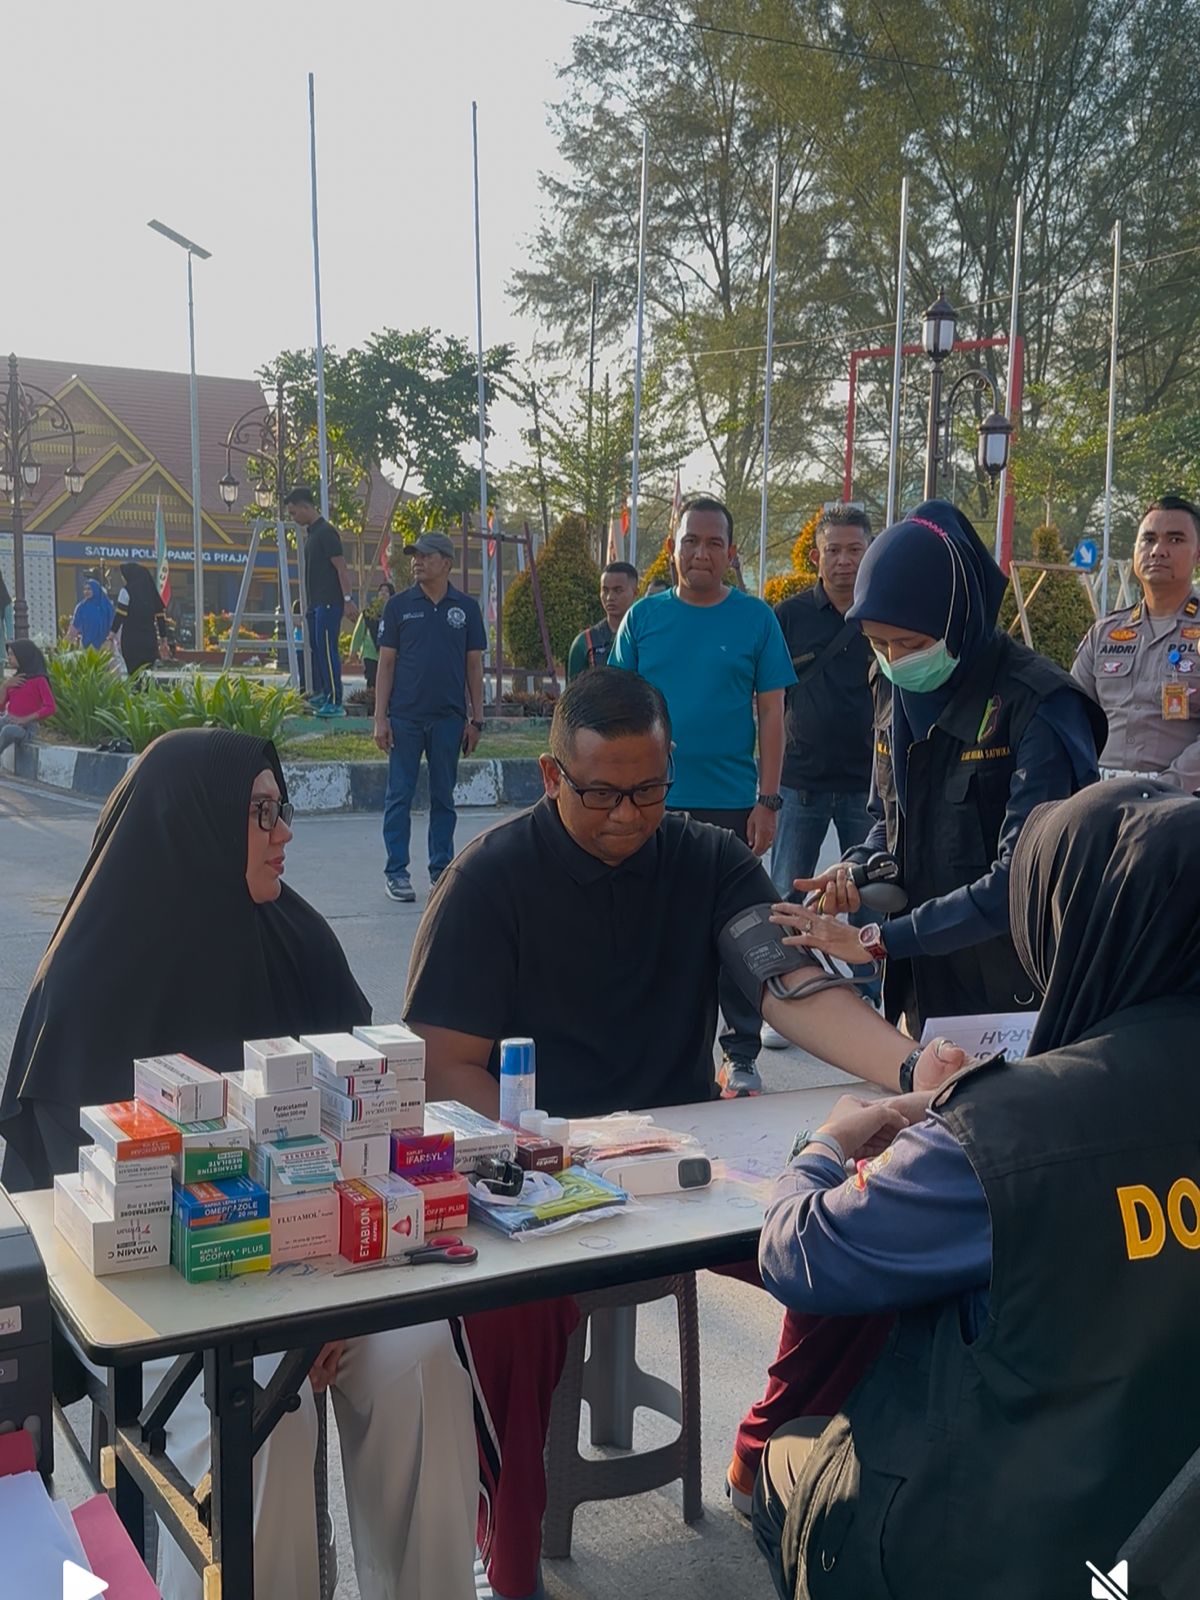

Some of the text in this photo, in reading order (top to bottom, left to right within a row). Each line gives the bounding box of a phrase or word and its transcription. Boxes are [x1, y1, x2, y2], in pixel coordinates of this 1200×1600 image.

[84, 545, 129, 558] SATUAN
[131, 547, 160, 559] POLIS
[214, 551, 249, 563] PRAJA
[1100, 644, 1137, 654] ANDRI
[273, 1101, 308, 1112] Paracetamol
[247, 1210, 258, 1218] mg
[277, 1211, 318, 1224] FLUTAMOL
[1116, 1177, 1200, 1260] DO
[359, 1207, 371, 1257] ETABION
[107, 1251, 115, 1259] C
[117, 1245, 158, 1258] VITAMIN
[242, 1244, 264, 1255] PLUS
